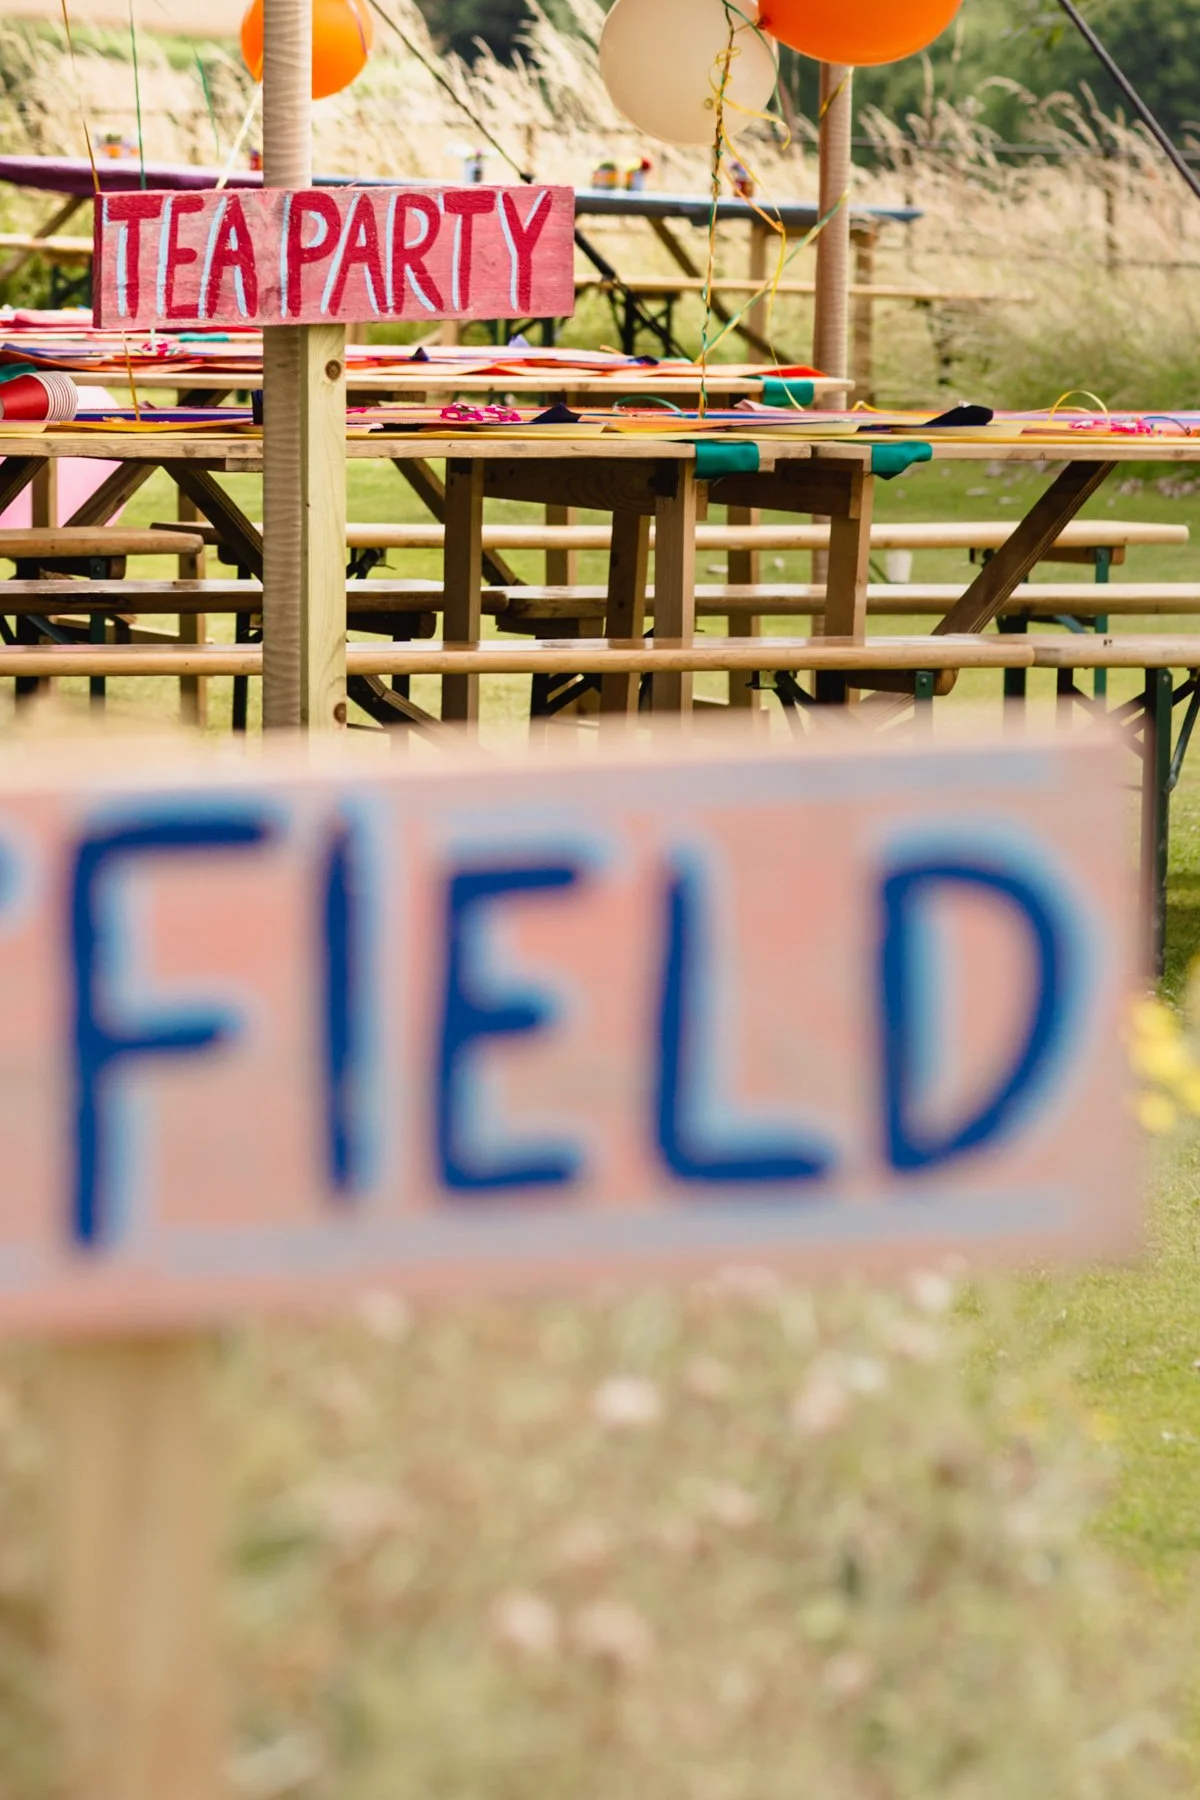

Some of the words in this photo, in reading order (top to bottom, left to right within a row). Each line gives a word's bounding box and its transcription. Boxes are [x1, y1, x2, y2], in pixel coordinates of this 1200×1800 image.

[103, 192, 258, 319] TEA
[279, 189, 553, 318] PARTY
[64, 796, 1092, 1252] FIELD
